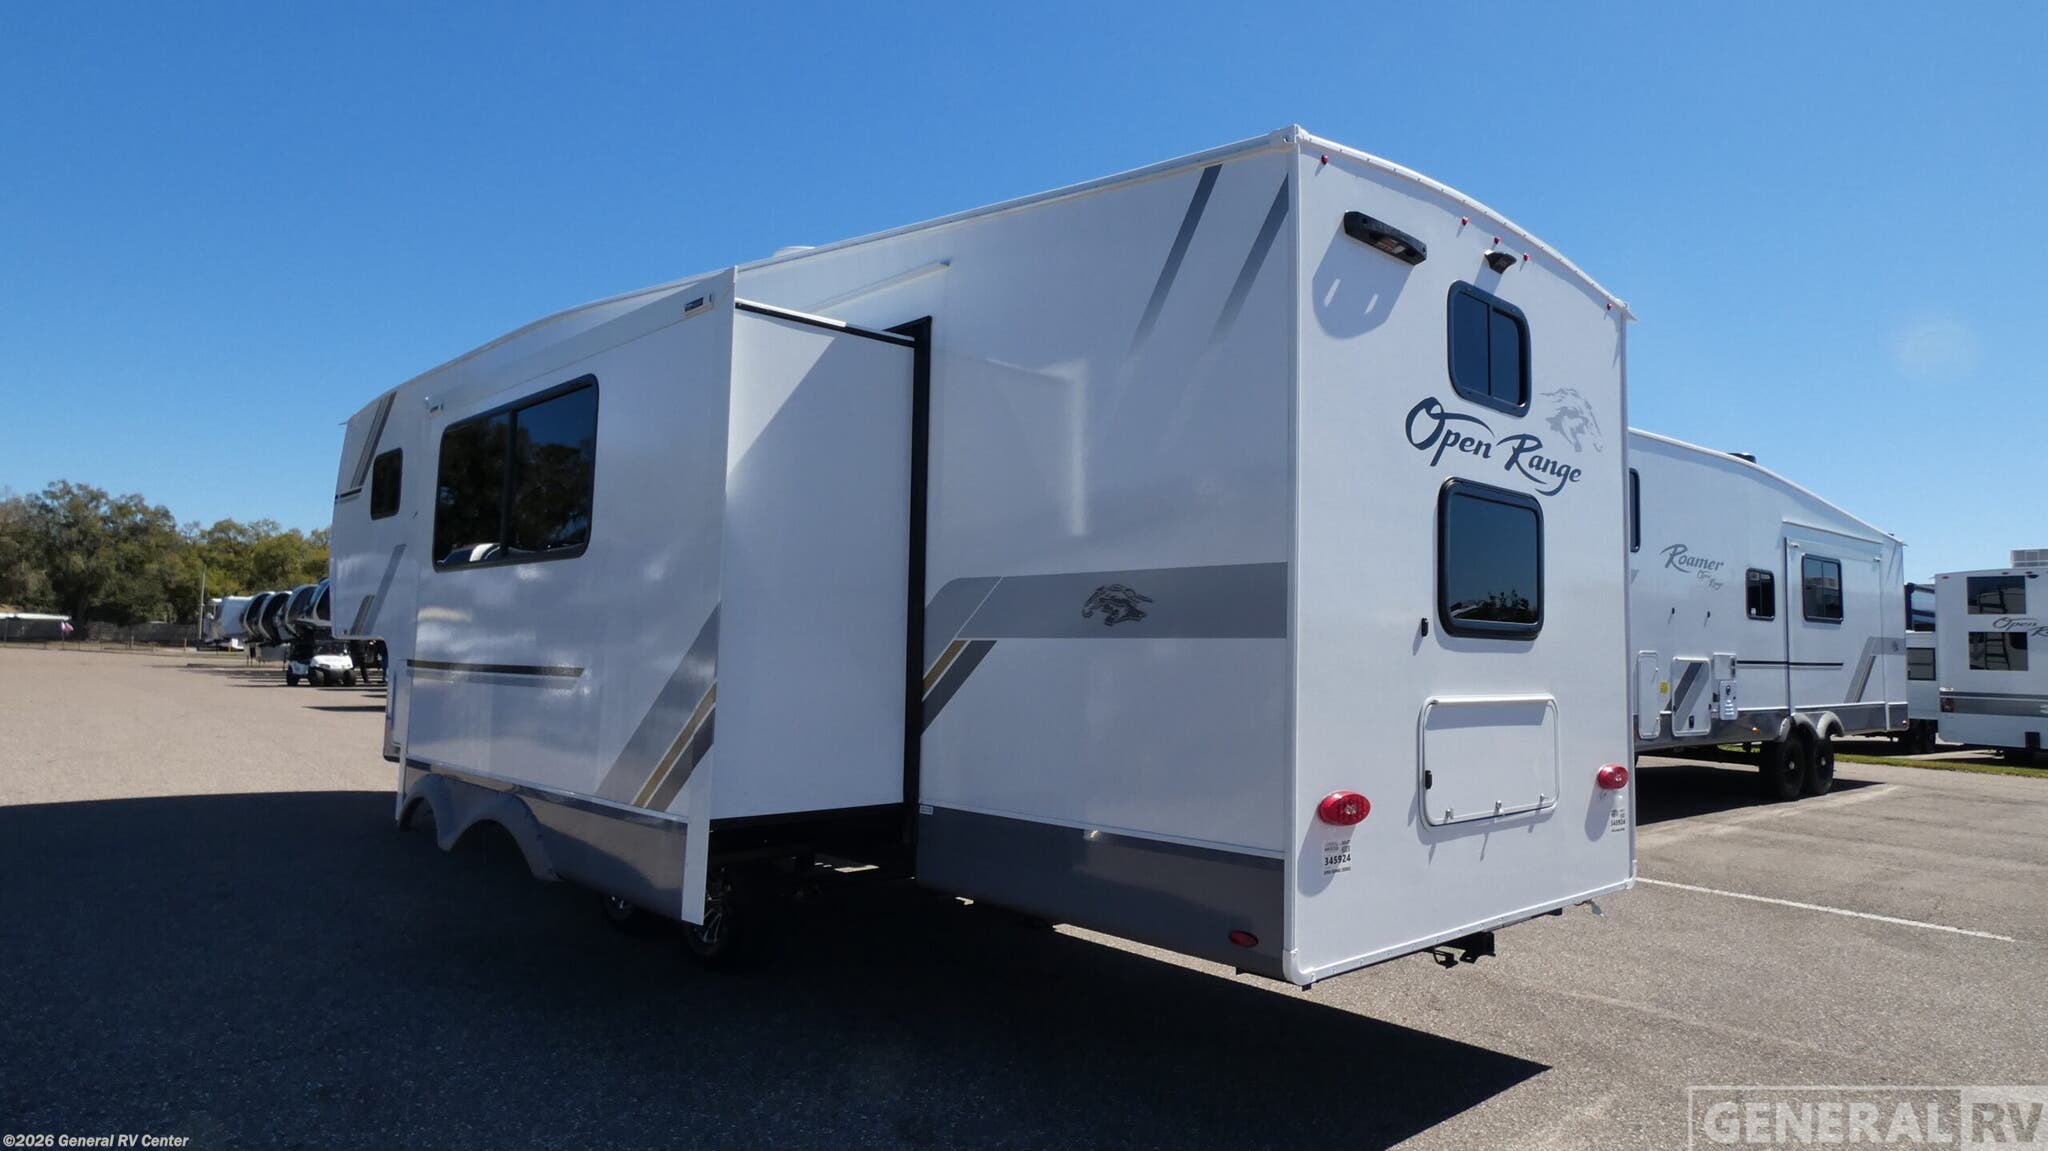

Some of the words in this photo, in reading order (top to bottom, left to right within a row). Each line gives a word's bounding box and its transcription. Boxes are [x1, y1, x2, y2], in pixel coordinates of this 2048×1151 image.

[1405, 396, 1495, 467] Open
[1496, 433, 1582, 497] Range
[1659, 543, 1724, 574] Roamer
[1324, 853, 1351, 866] 345924
